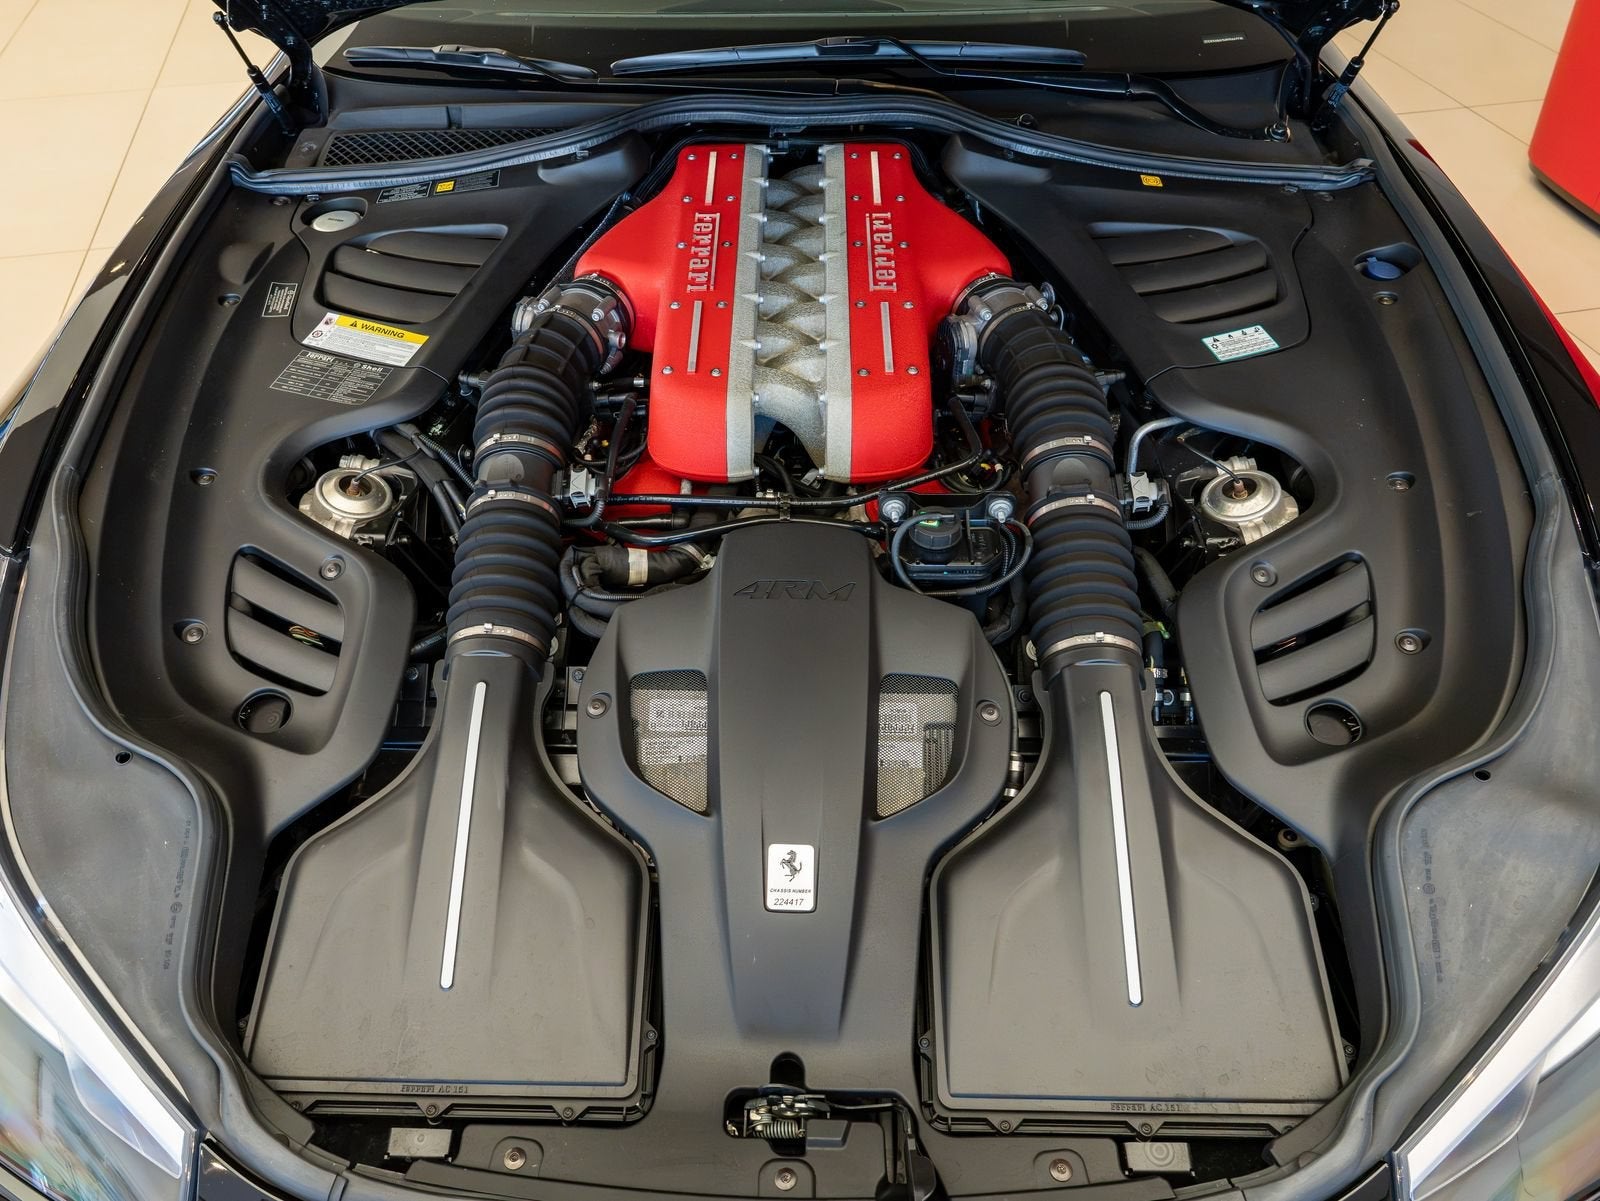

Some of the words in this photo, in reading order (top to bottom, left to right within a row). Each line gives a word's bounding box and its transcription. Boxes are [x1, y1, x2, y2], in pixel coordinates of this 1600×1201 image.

[686, 212, 720, 293] Ferrari
[865, 211, 898, 292] Ferrari
[360, 322, 405, 339] WARNING
[305, 351, 336, 363] Ferrari
[361, 364, 384, 373] Shell
[733, 578, 857, 601] 4RM
[773, 897, 805, 906] 224417
